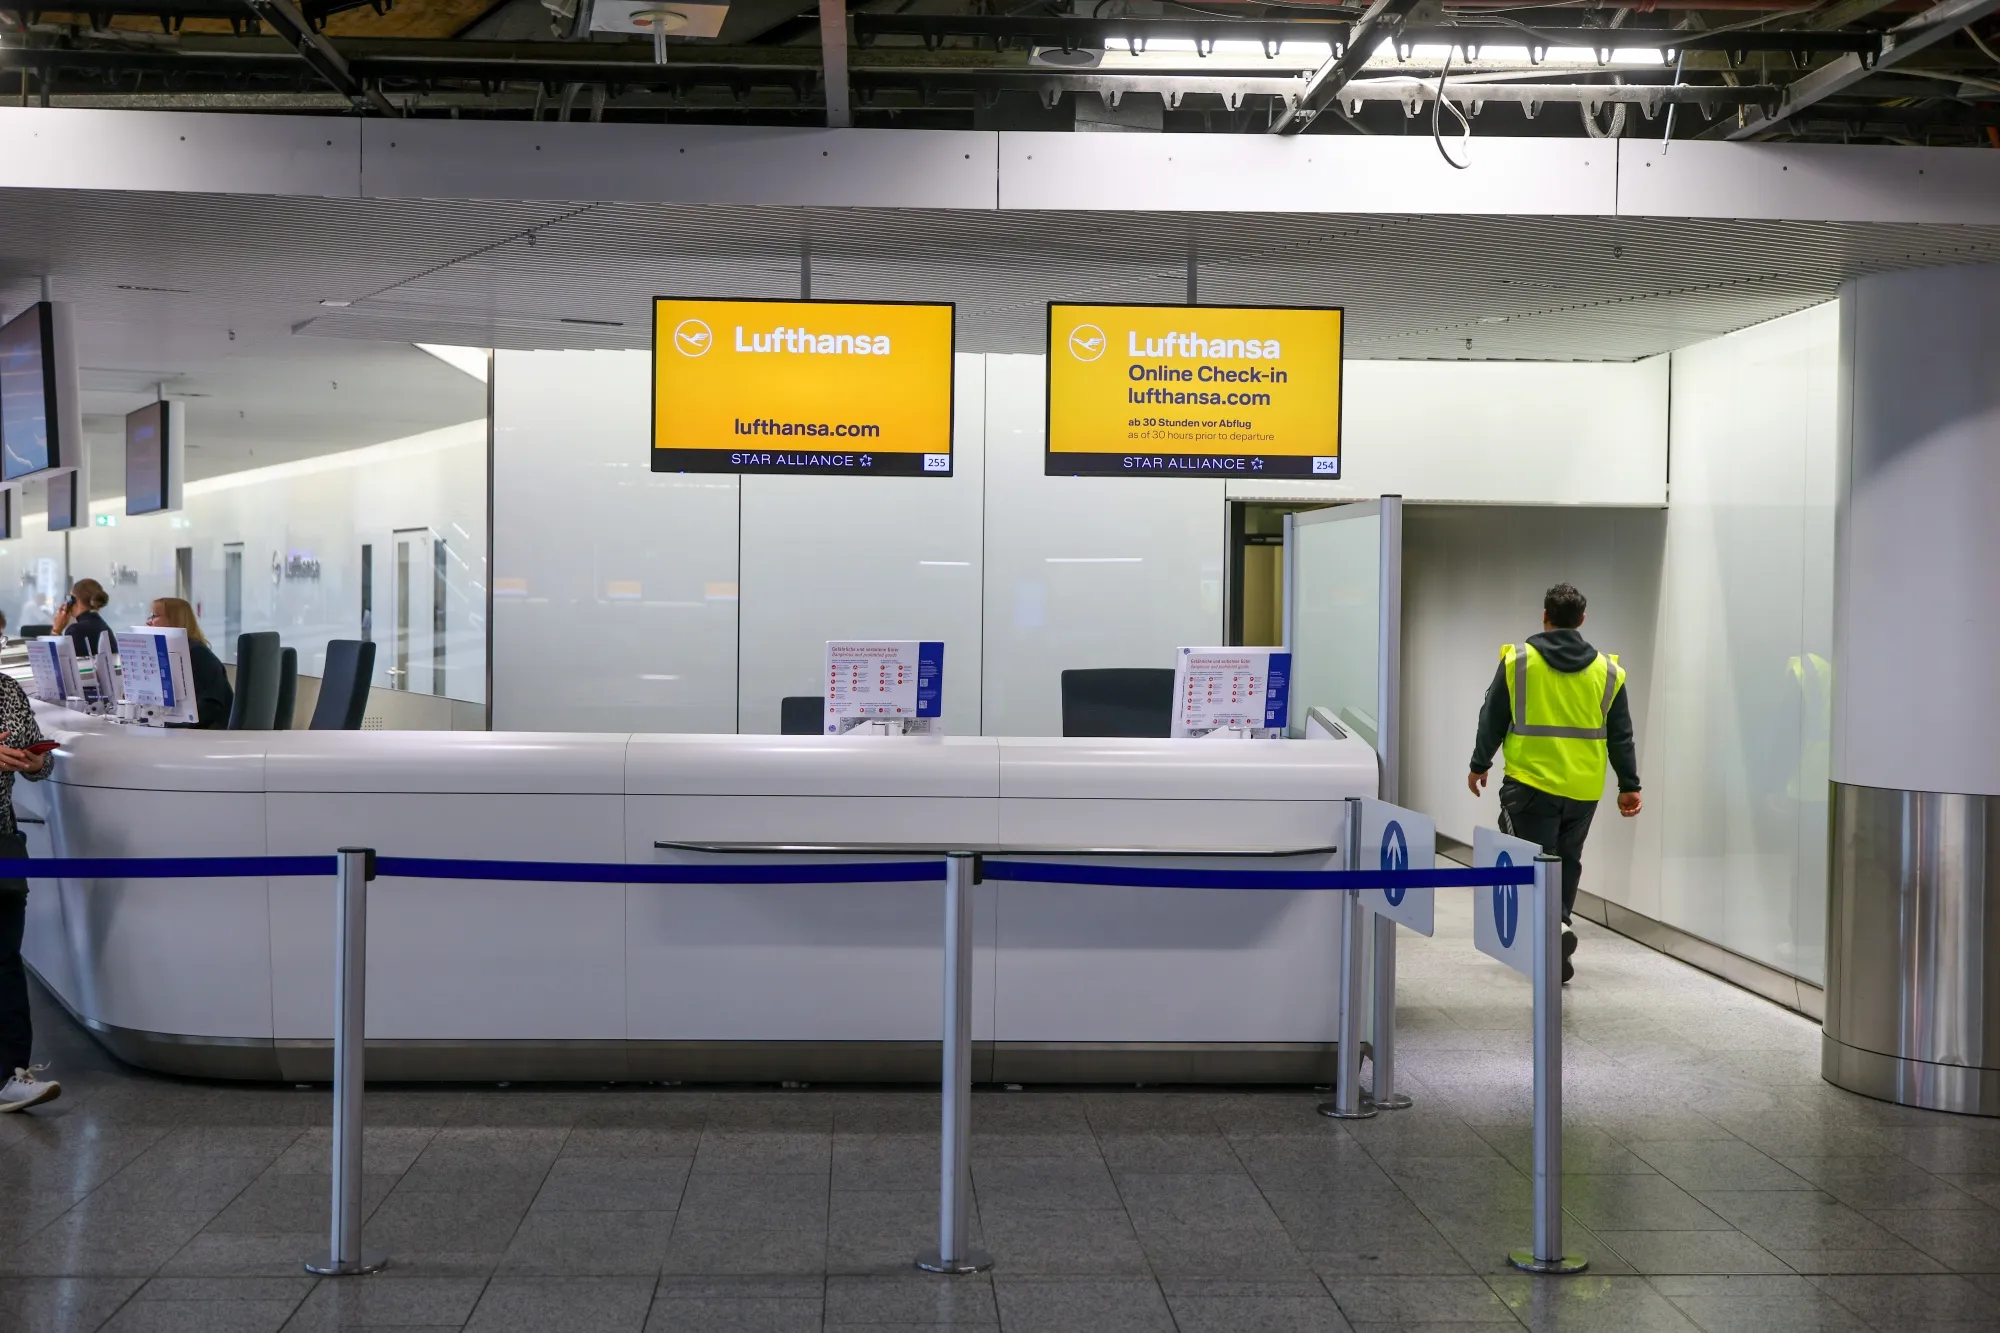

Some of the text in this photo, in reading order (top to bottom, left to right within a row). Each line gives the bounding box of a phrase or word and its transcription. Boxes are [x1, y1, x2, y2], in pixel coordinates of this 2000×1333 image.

[735, 325, 890, 355] Lufthansa
[1128, 331, 1280, 359] Lufthansa
[1128, 365, 1287, 383] Online Check-in
[1128, 388, 1271, 406] lufthansa.com
[734, 418, 880, 438] lufthansa.com
[1128, 418, 1252, 430] ab 30 Stunden vor Abflug
[1141, 431, 1150, 439] of
[1152, 431, 1166, 440] 30
[1167, 431, 1194, 440] hours
[1195, 431, 1216, 442] prior
[1218, 432, 1228, 440] to
[1229, 431, 1275, 443] departure
[731, 453, 854, 467] STAR ALLIANCE
[928, 458, 945, 467] 255
[1123, 457, 1245, 470] STAR ALLIANCE
[1317, 461, 1334, 470] 254
